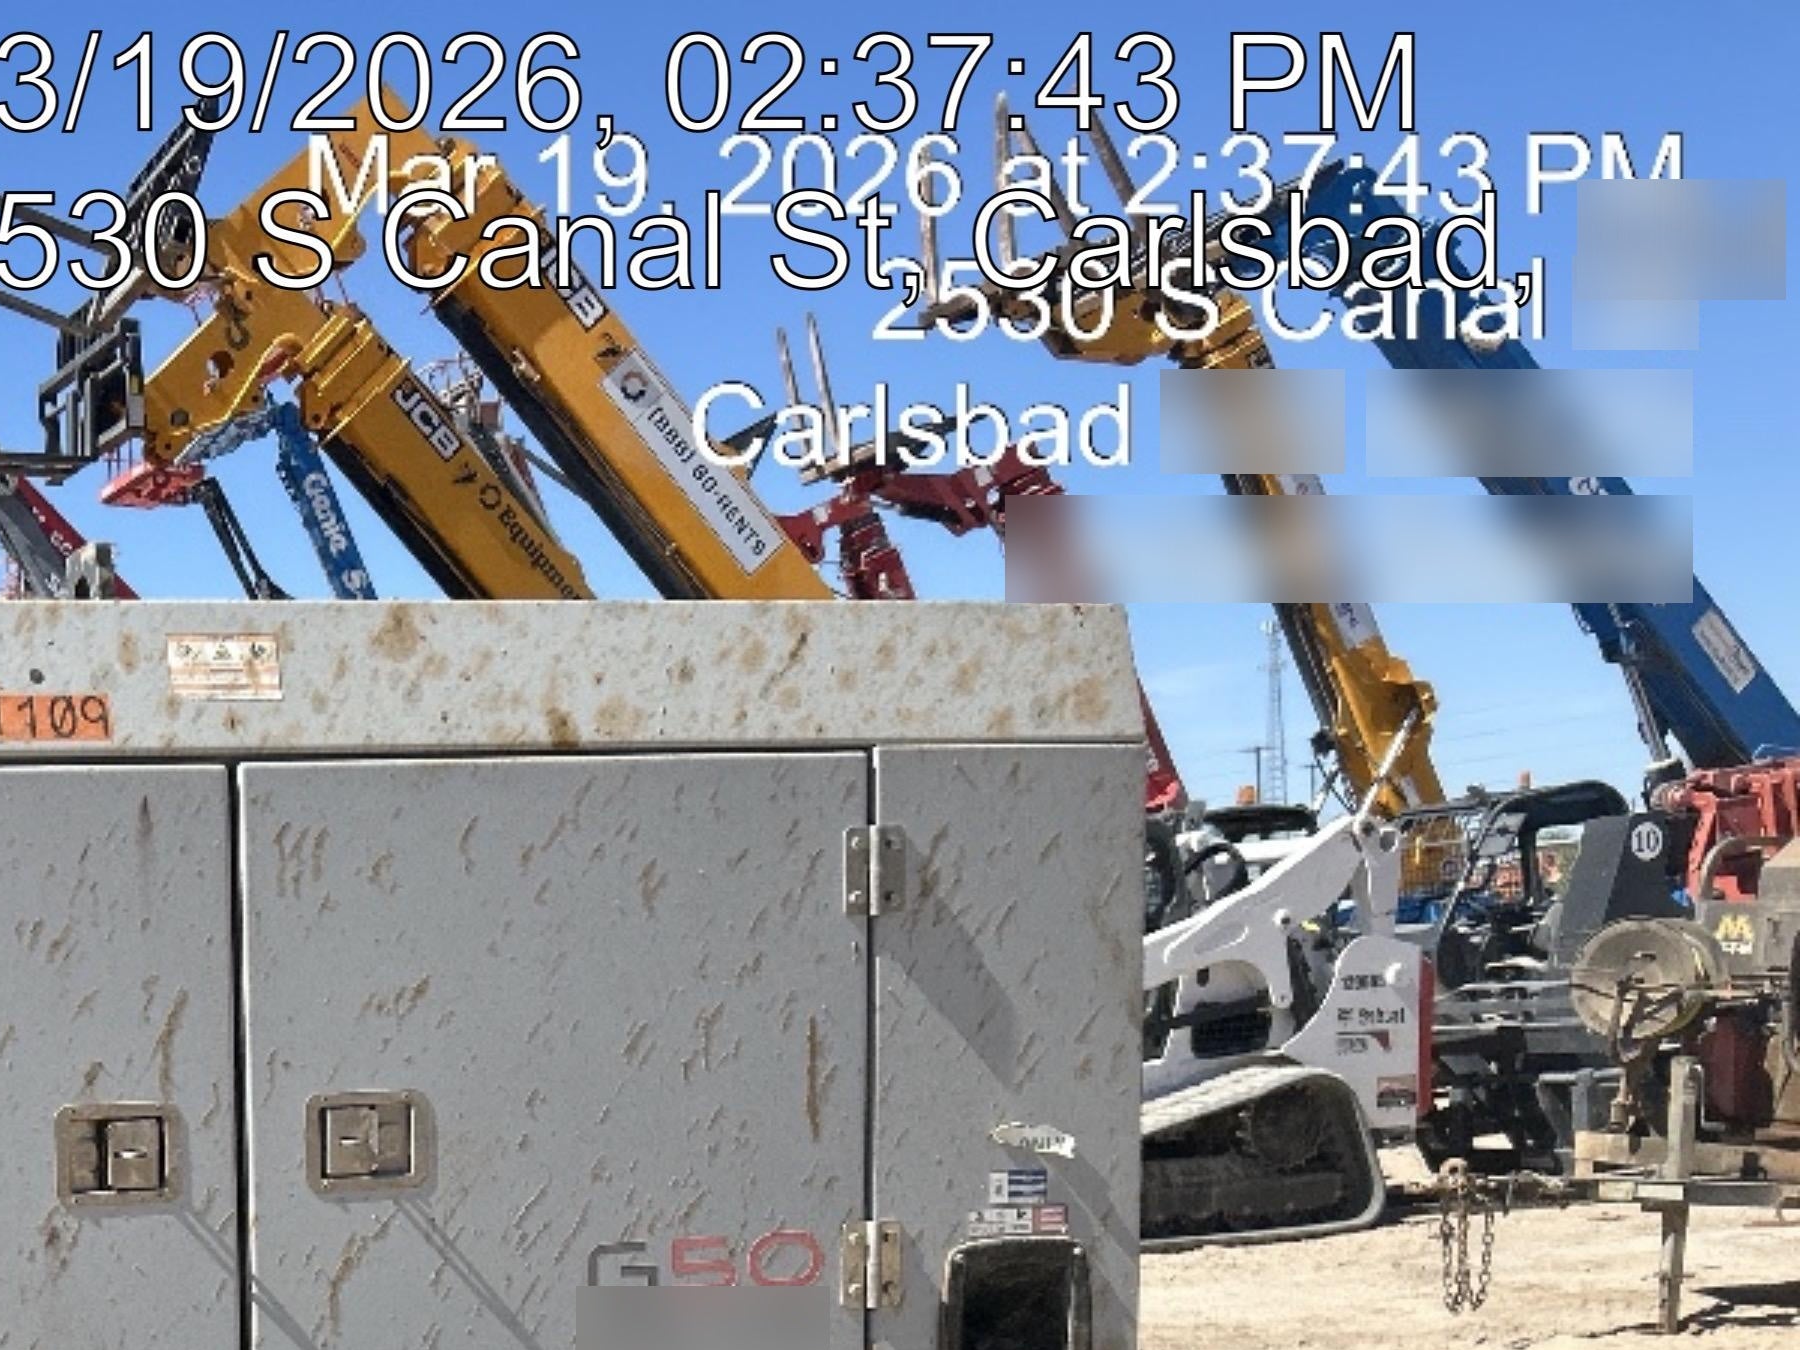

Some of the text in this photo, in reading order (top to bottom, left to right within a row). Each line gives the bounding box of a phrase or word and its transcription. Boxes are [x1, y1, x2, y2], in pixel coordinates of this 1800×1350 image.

[394, 386, 461, 461] JCB
[302, 472, 348, 557] Genie
[1634, 828, 1660, 853] 10
[587, 1228, 826, 1287] G50
